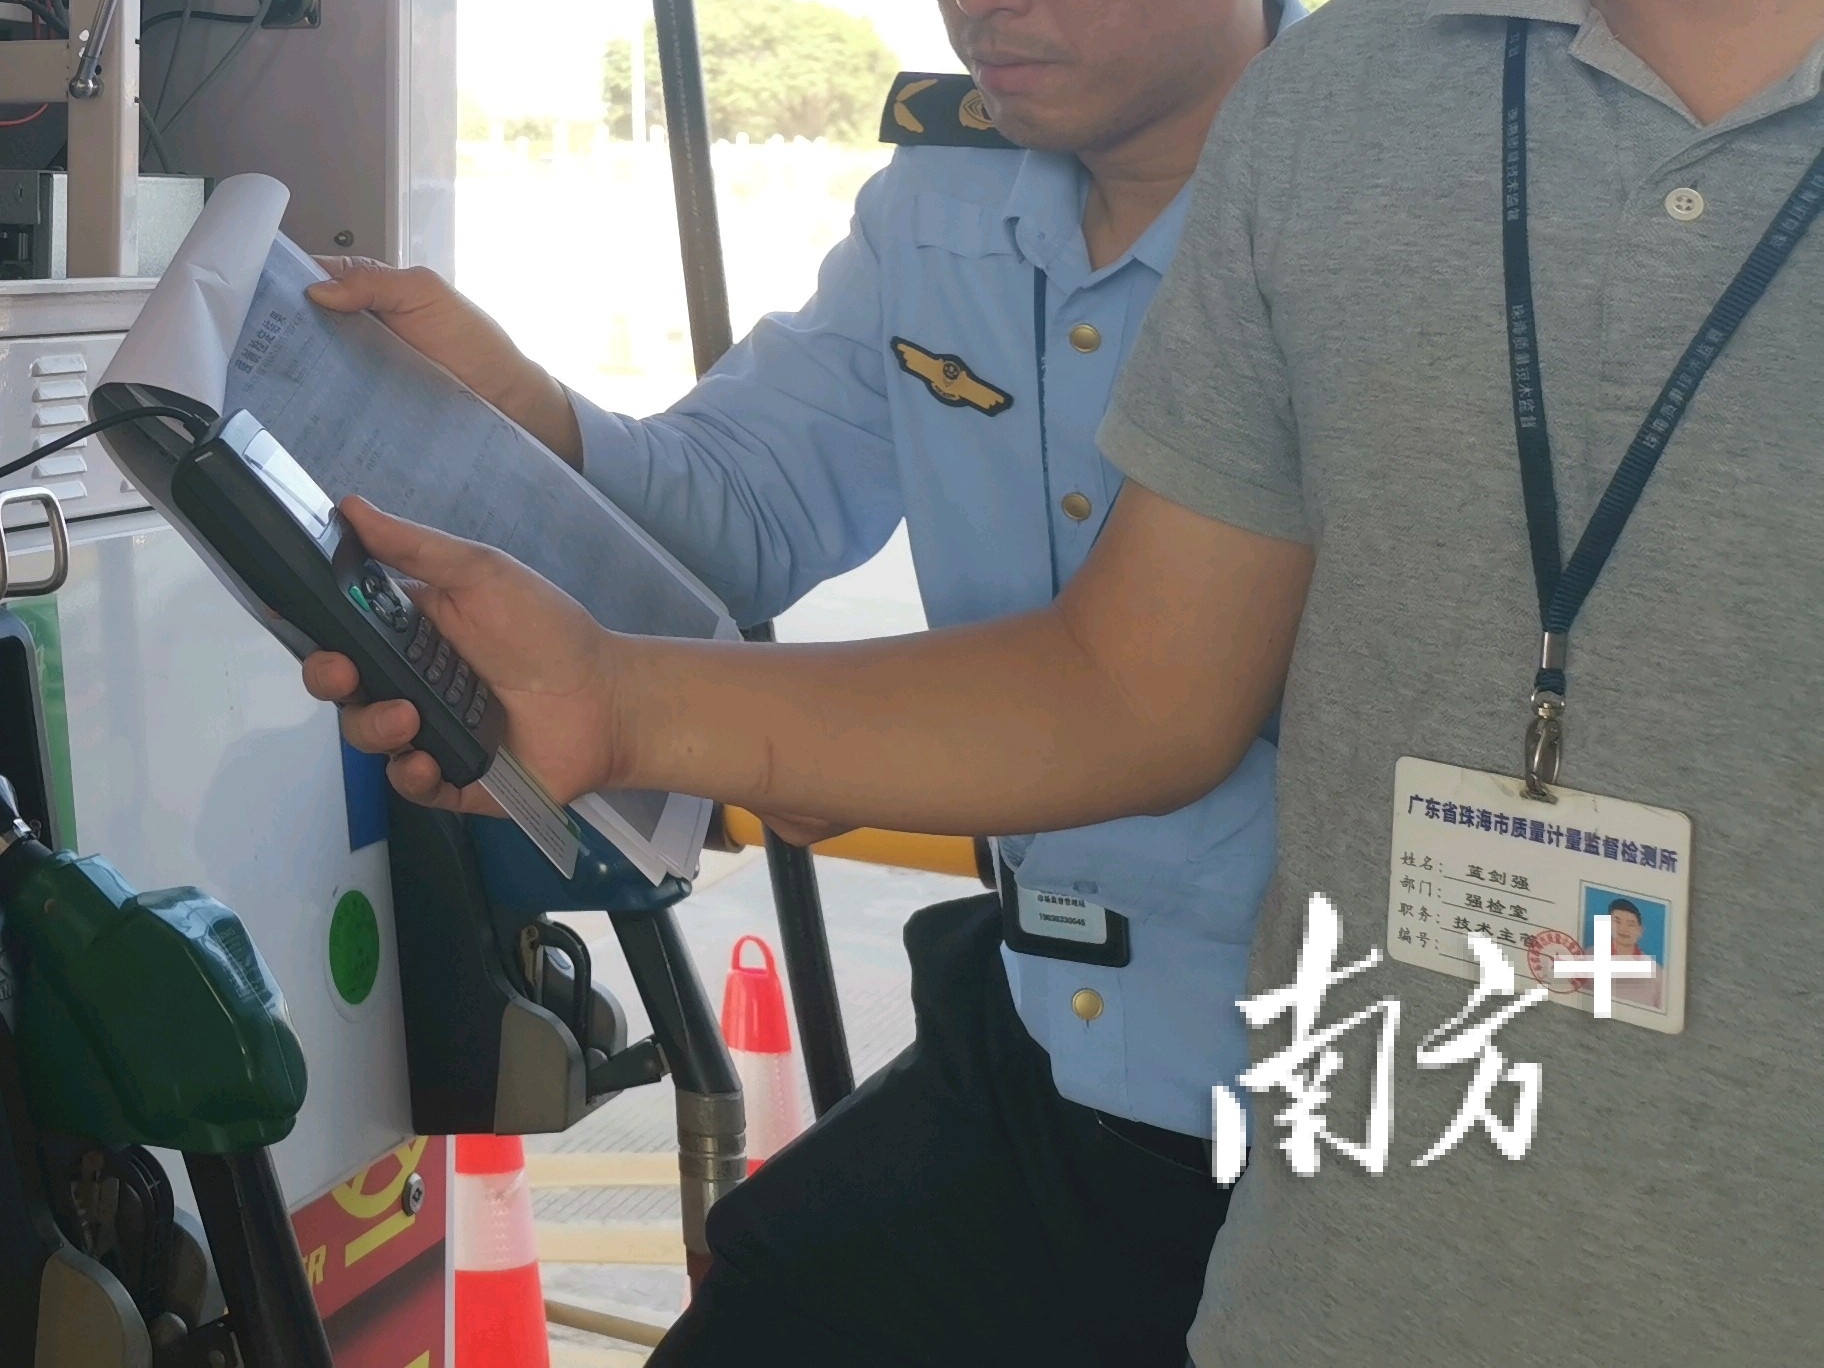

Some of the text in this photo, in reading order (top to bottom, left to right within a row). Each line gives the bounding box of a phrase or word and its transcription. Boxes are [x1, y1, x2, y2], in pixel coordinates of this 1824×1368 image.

[1407, 794, 1678, 873] 广东省珠海市质量计量监督检测所
